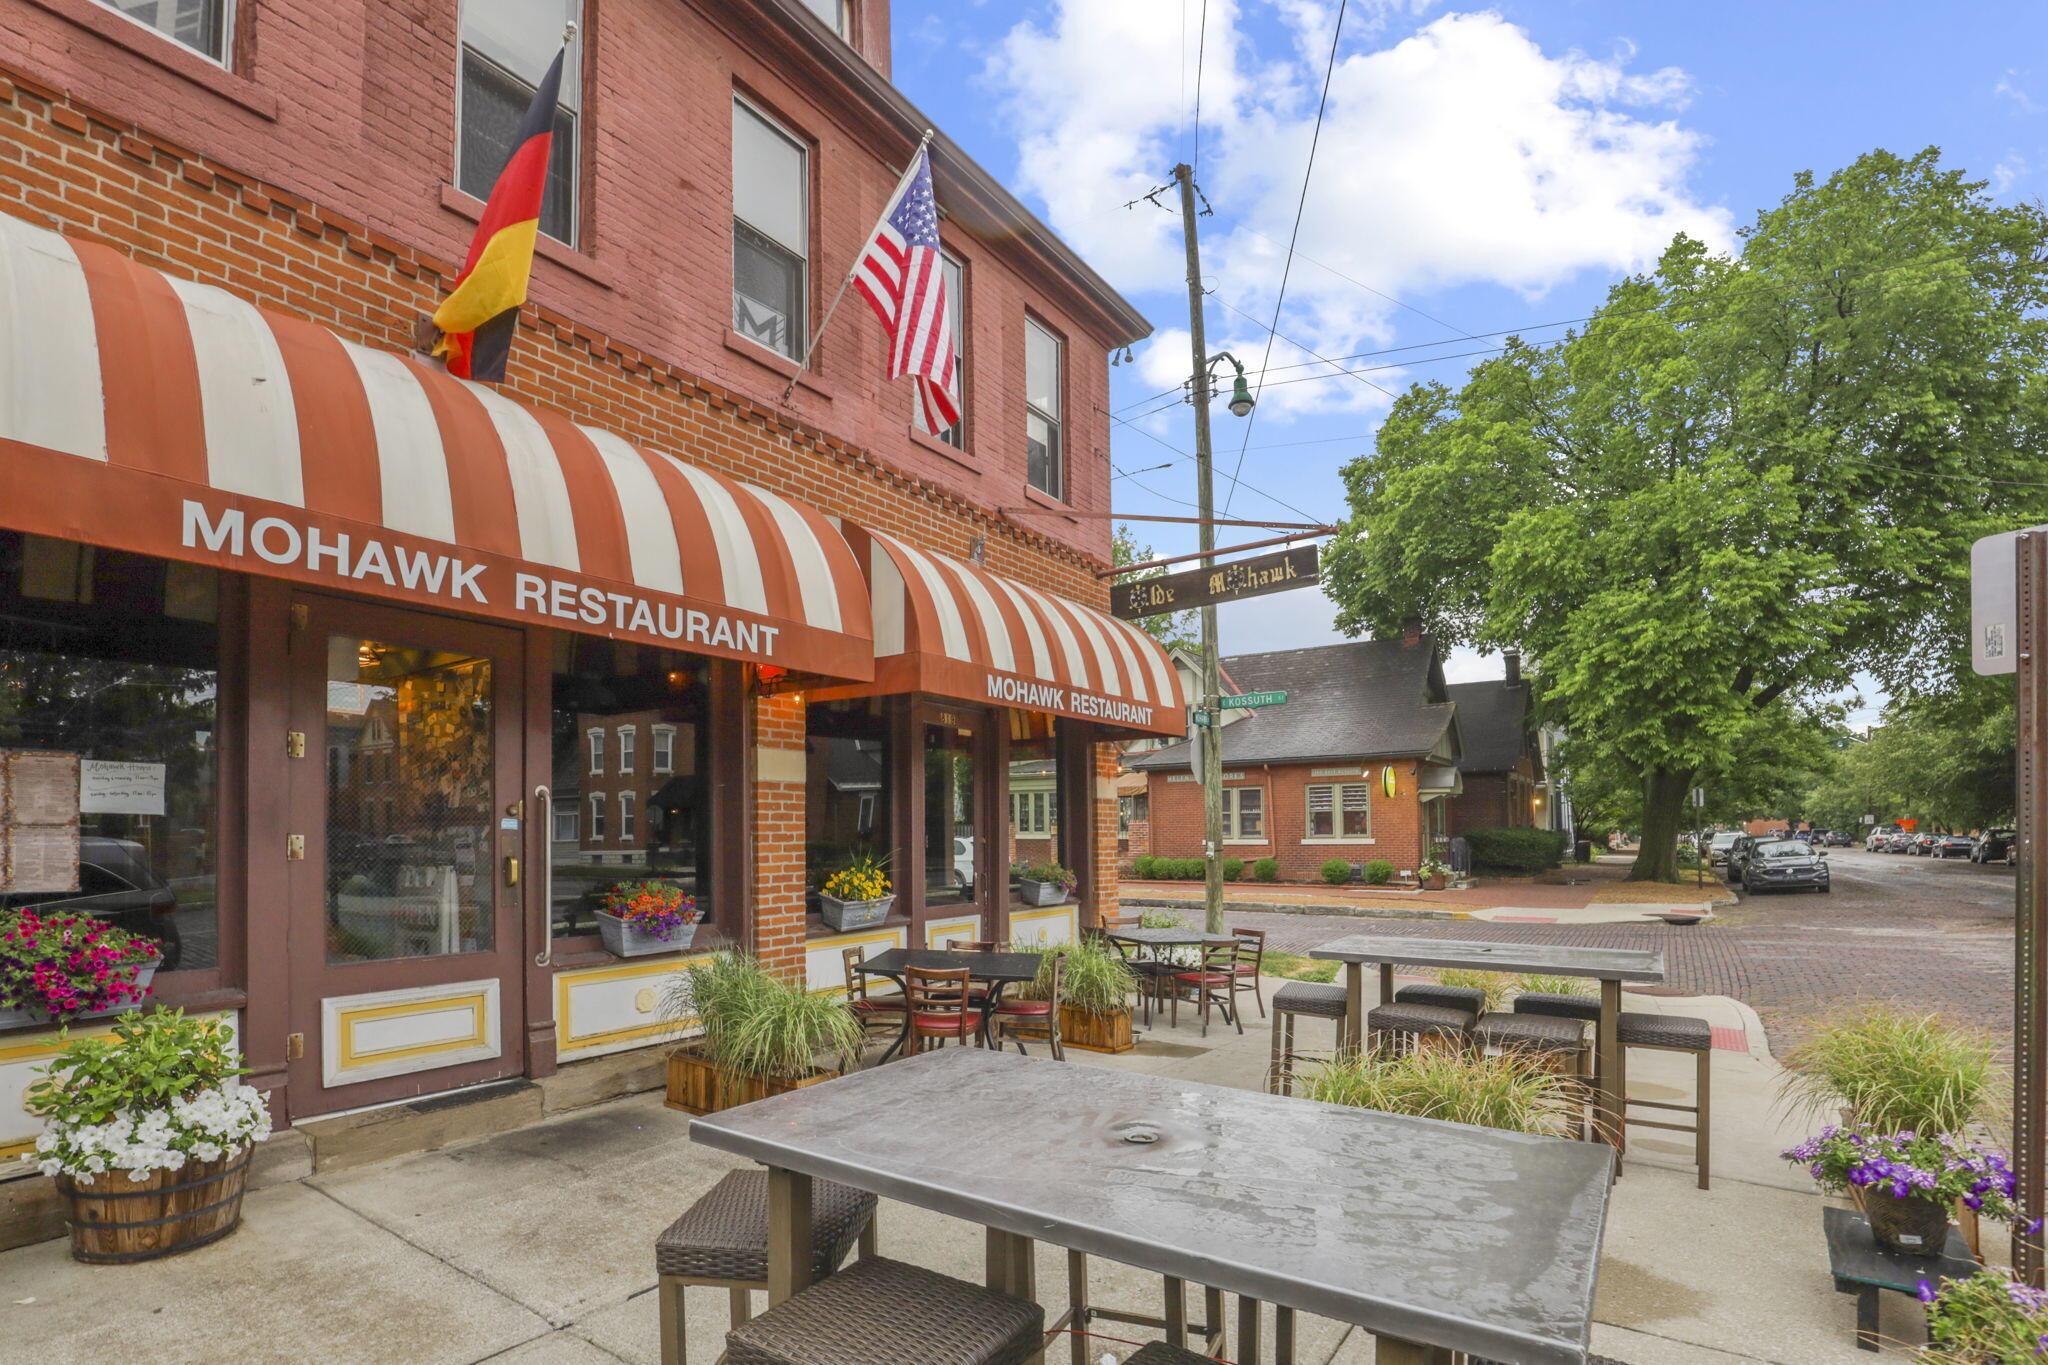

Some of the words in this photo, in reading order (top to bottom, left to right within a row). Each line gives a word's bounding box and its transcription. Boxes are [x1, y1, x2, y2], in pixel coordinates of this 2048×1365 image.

[182, 499, 488, 605] MOHAWK
[515, 573, 779, 656] RESTAURANT
[987, 674, 1065, 710] MOHAWK
[1071, 692, 1153, 726] RESTAURANT
[1229, 694, 1273, 707] KOSSUTH
